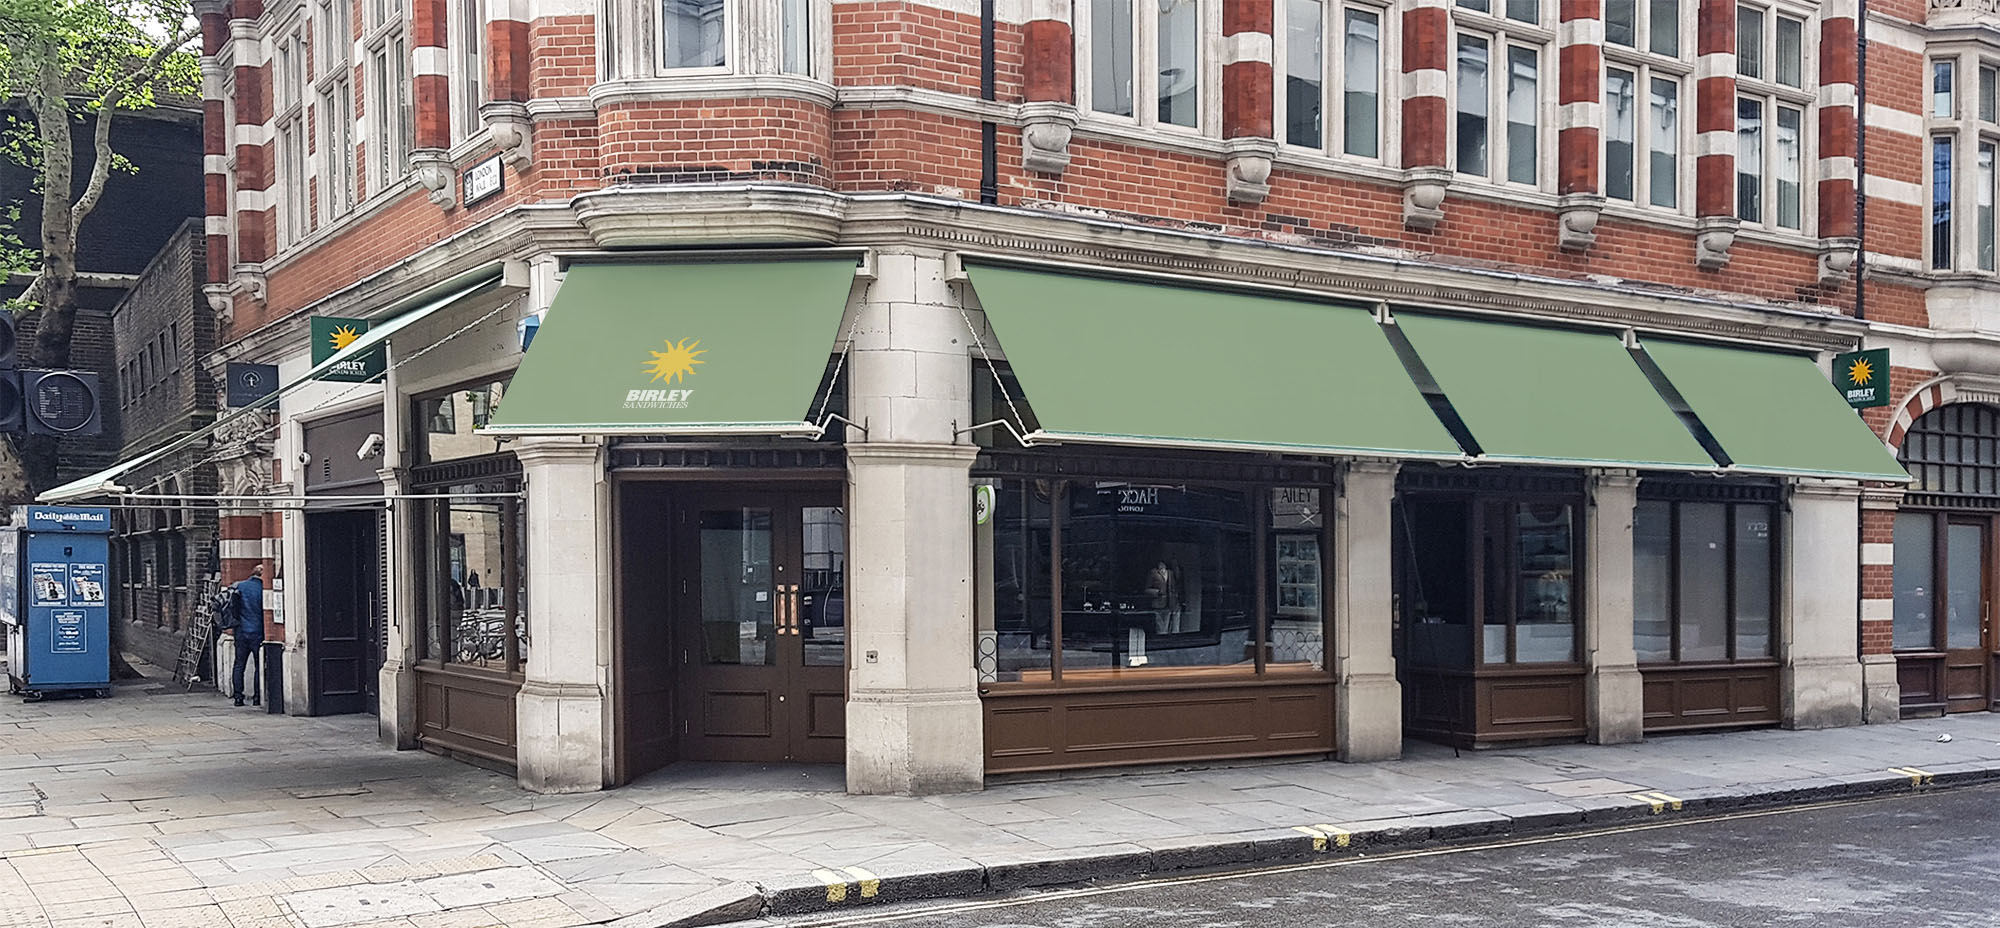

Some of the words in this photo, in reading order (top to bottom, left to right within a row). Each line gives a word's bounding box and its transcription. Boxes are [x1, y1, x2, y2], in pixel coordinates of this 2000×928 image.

[331, 360, 366, 371] IRLEY
[626, 389, 694, 401] BIRLEY
[1847, 388, 1875, 398] BIRLEY
[622, 401, 689, 409] SANDWICHES
[34, 511, 63, 522] Daily
[80, 513, 104, 521] Mail
